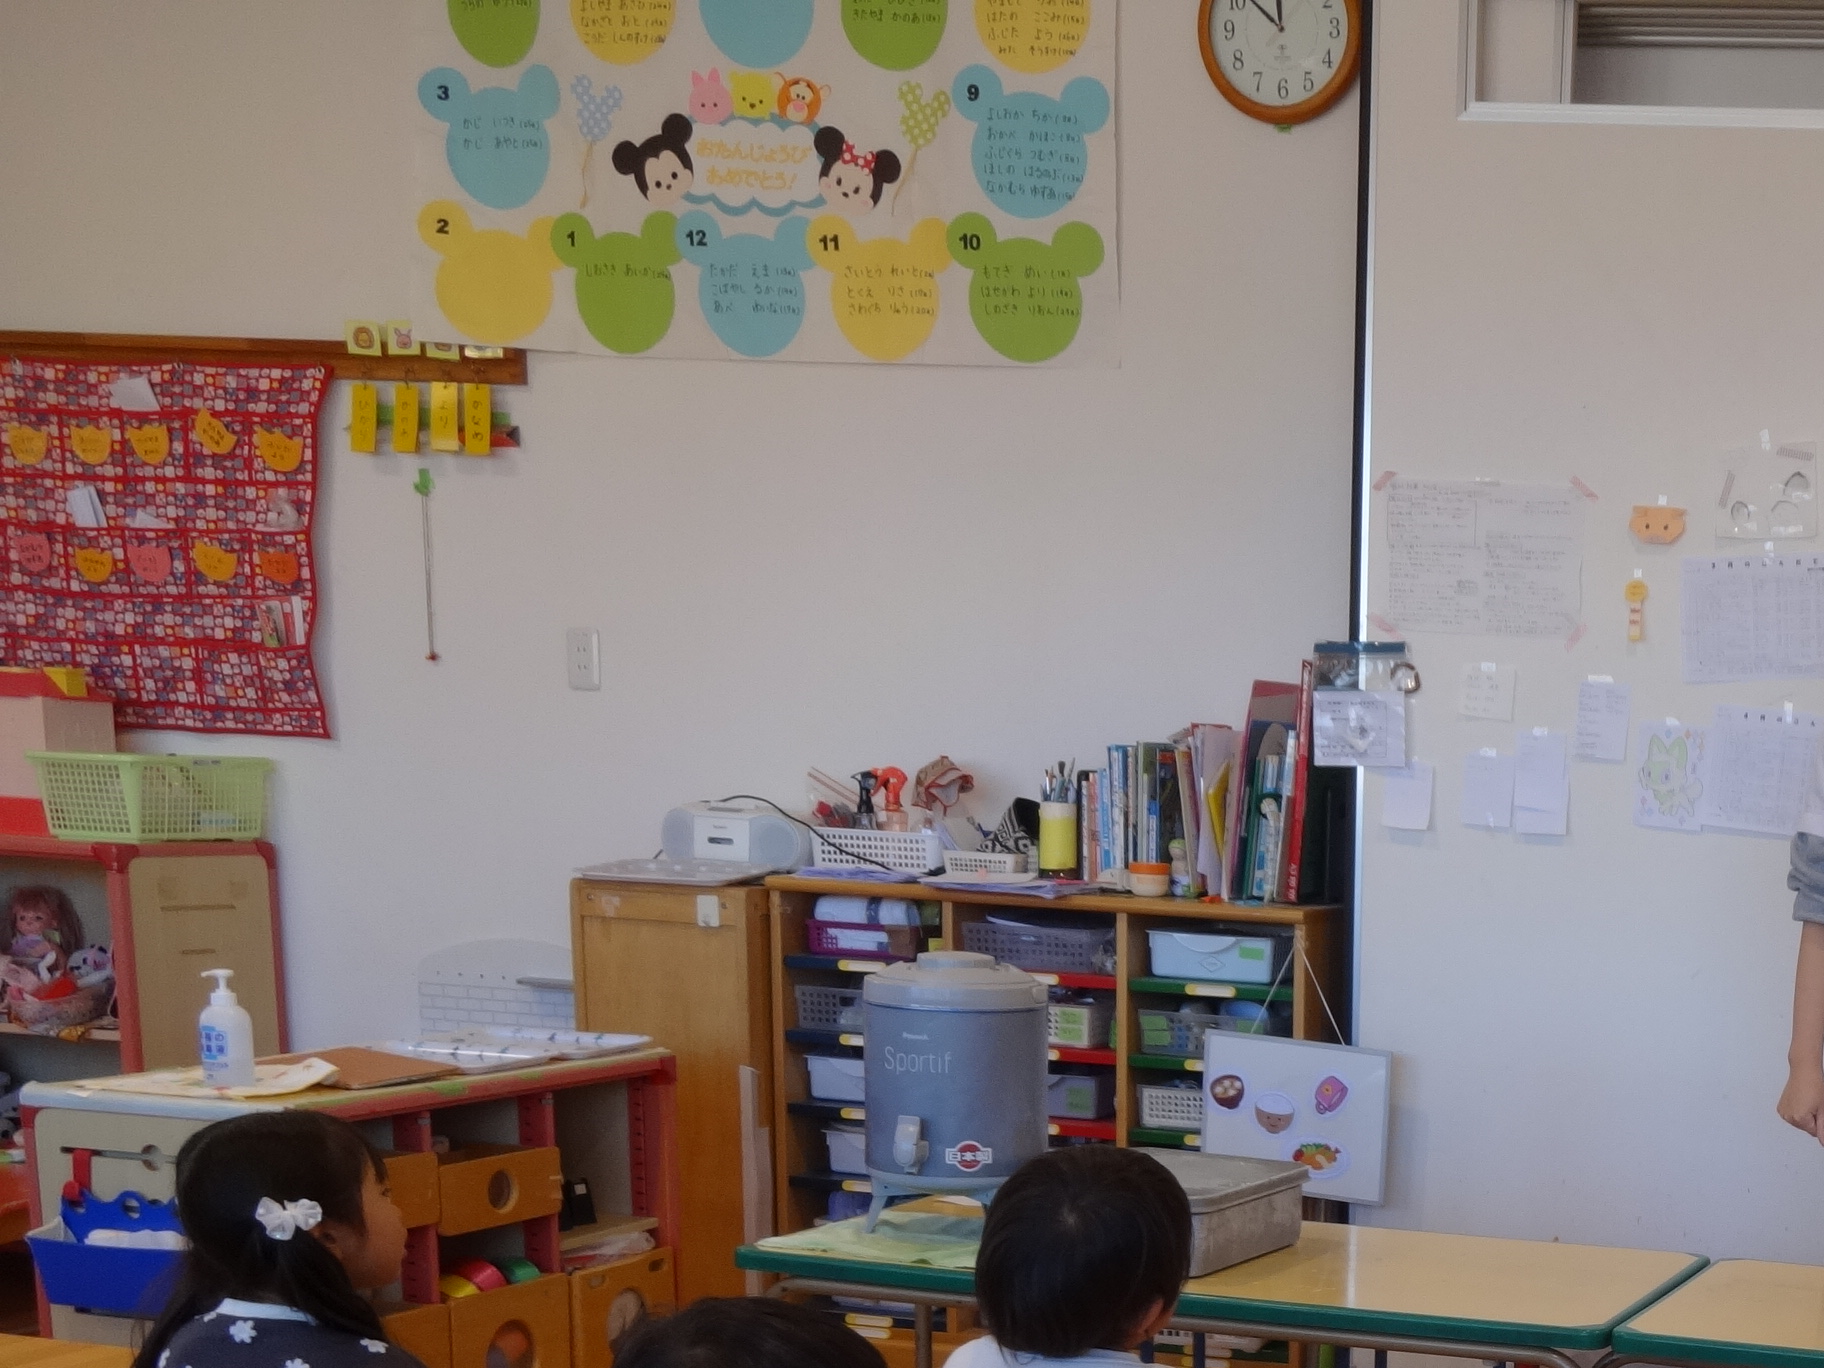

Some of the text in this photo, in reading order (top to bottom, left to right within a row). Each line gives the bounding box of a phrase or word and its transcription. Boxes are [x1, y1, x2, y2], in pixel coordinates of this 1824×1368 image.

[1224, 20, 1235, 41] 9
[1329, 17, 1341, 39] 3
[1233, 50, 1245, 71] 8
[1322, 48, 1333, 69] 4
[1253, 71, 1263, 93] 7
[1278, 78, 1289, 99] 6
[1303, 71, 1314, 92] 5
[437, 85, 450, 101] 3
[967, 84, 980, 102] 9
[436, 218, 449, 235] 2
[567, 230, 576, 247] 1
[685, 230, 708, 247] 12
[818, 234, 841, 252] 11
[959, 233, 981, 251] 10
[884, 1046, 952, 1075] Sportif
[948, 1150, 990, 1162] 日本製
